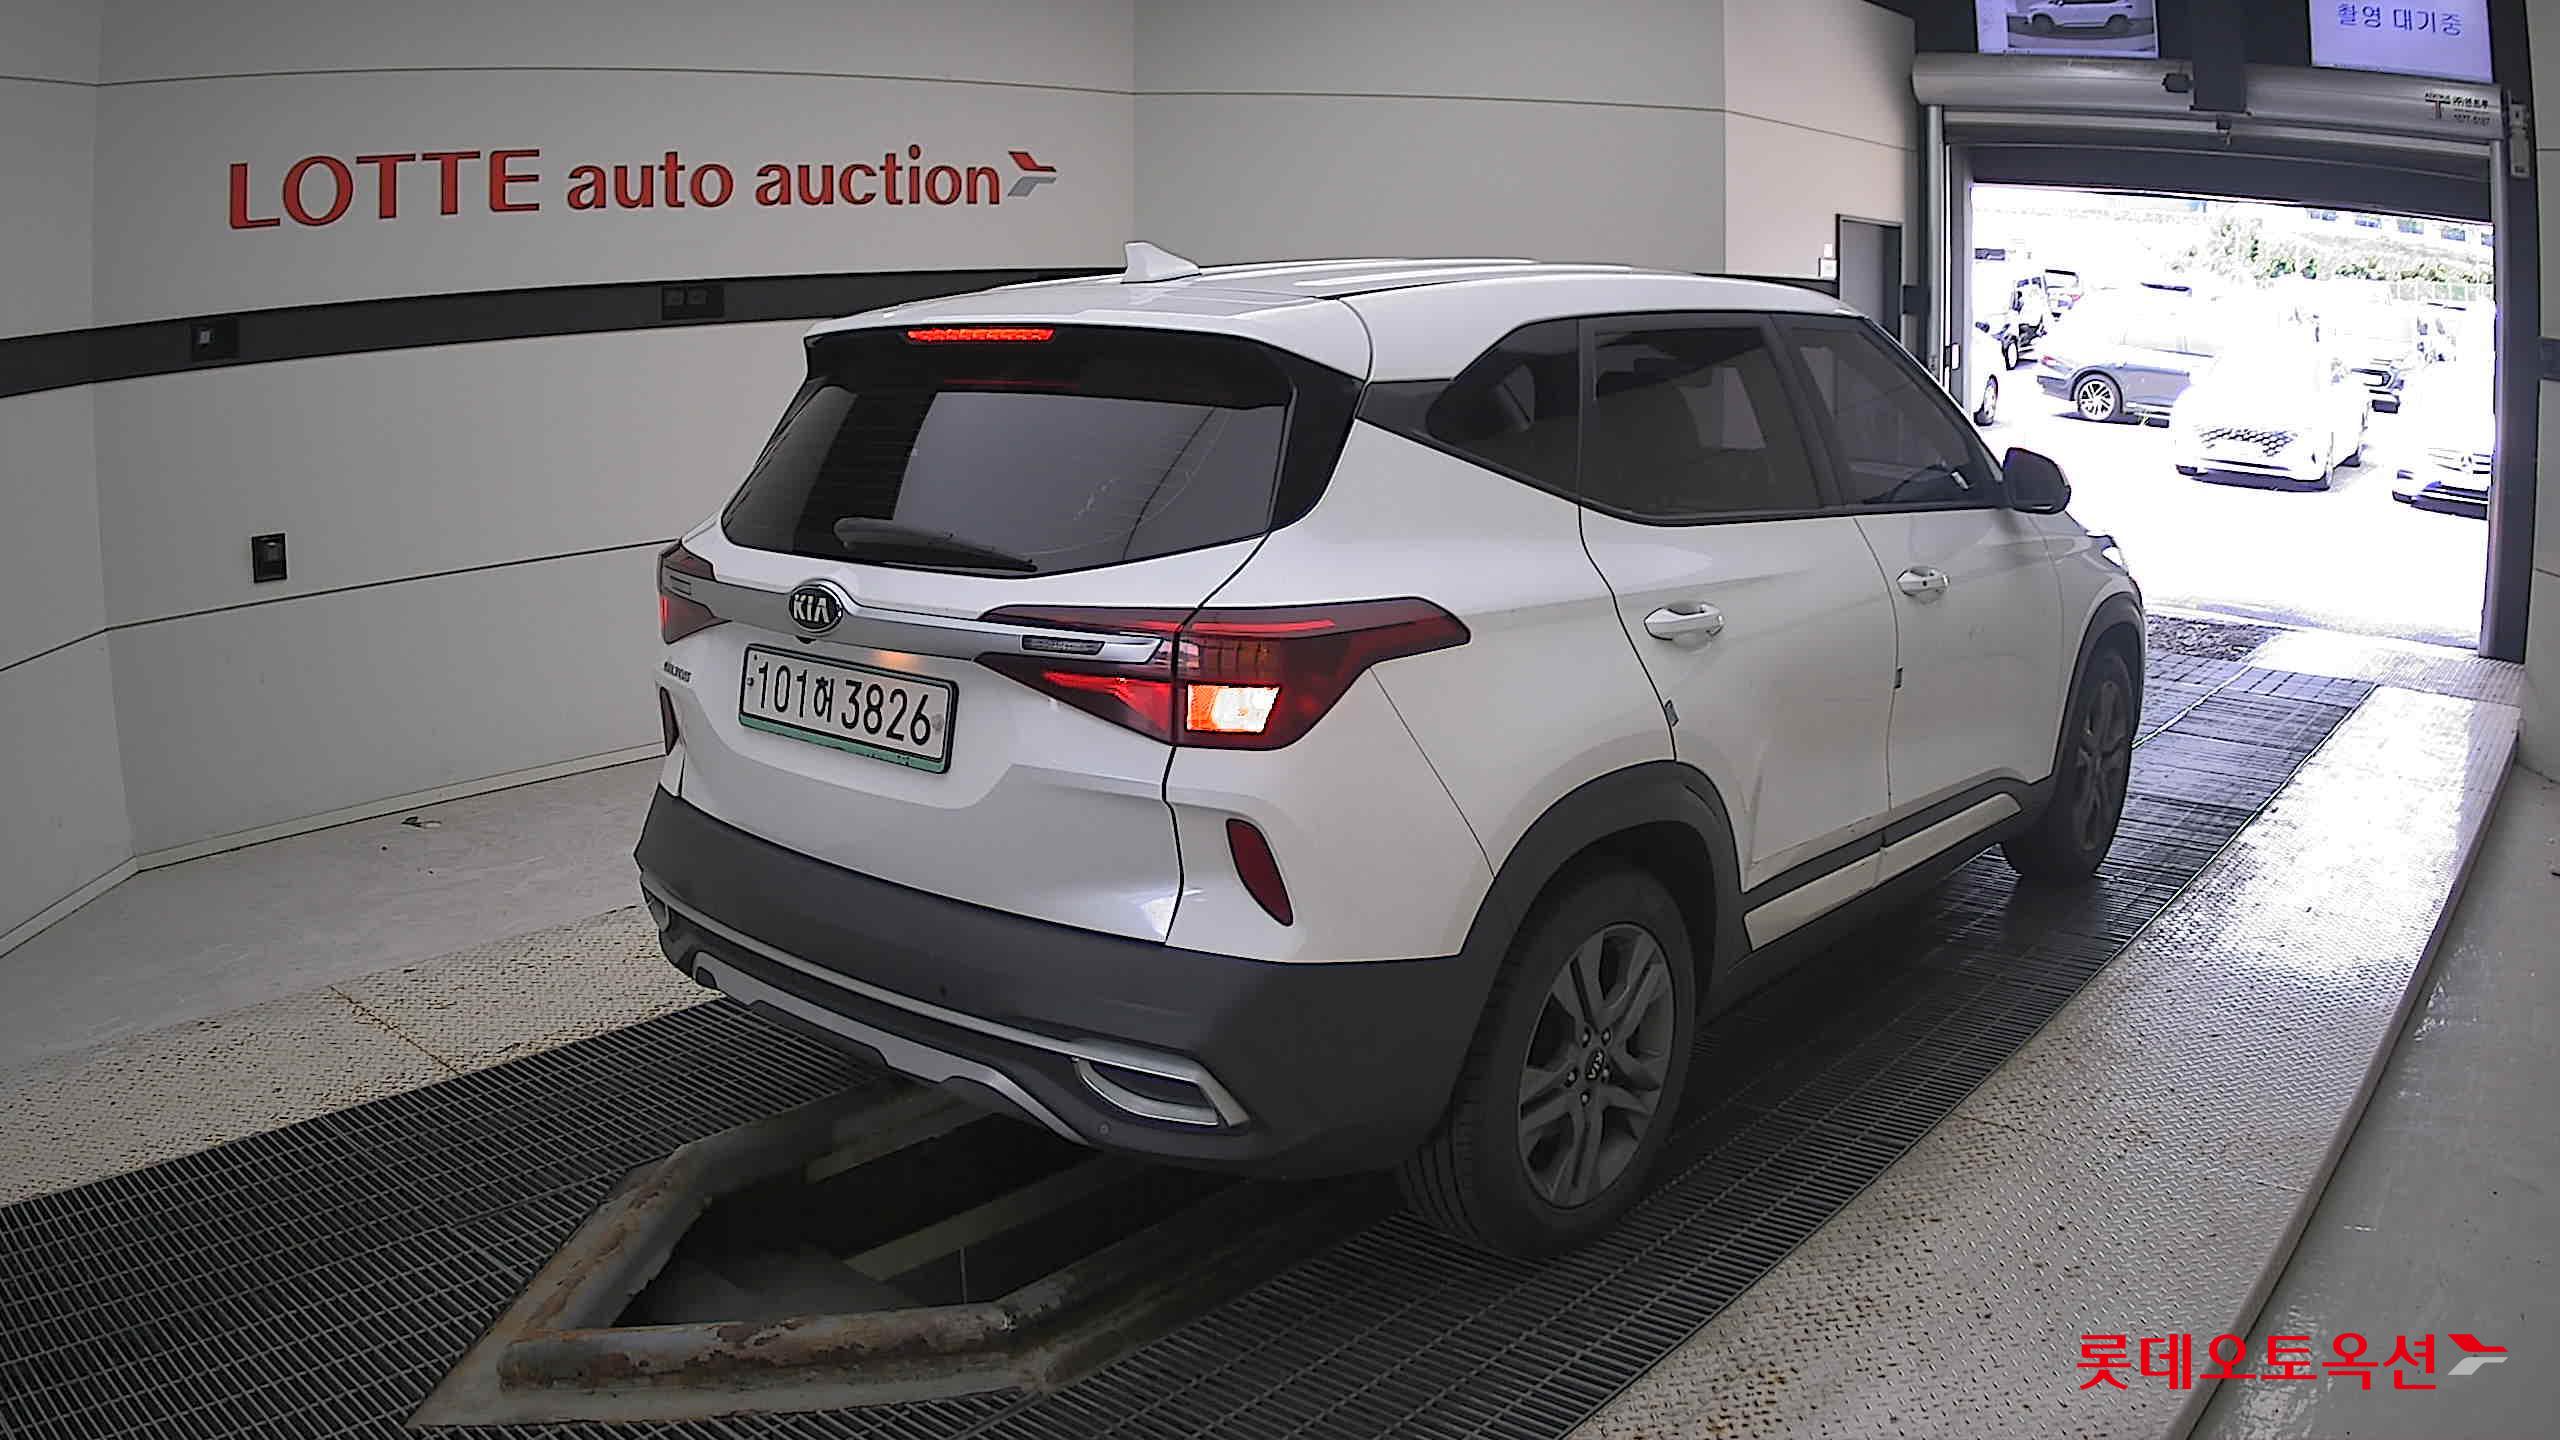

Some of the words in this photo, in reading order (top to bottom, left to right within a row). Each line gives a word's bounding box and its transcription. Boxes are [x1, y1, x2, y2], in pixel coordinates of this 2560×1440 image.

[2337, 3, 2382, 28] 촬영
[2393, 8, 2462, 36] 대기중
[229, 148, 541, 231] LOTTE
[566, 150, 734, 210] auto
[754, 144, 1001, 207] auction
[793, 594, 831, 623] KIA
